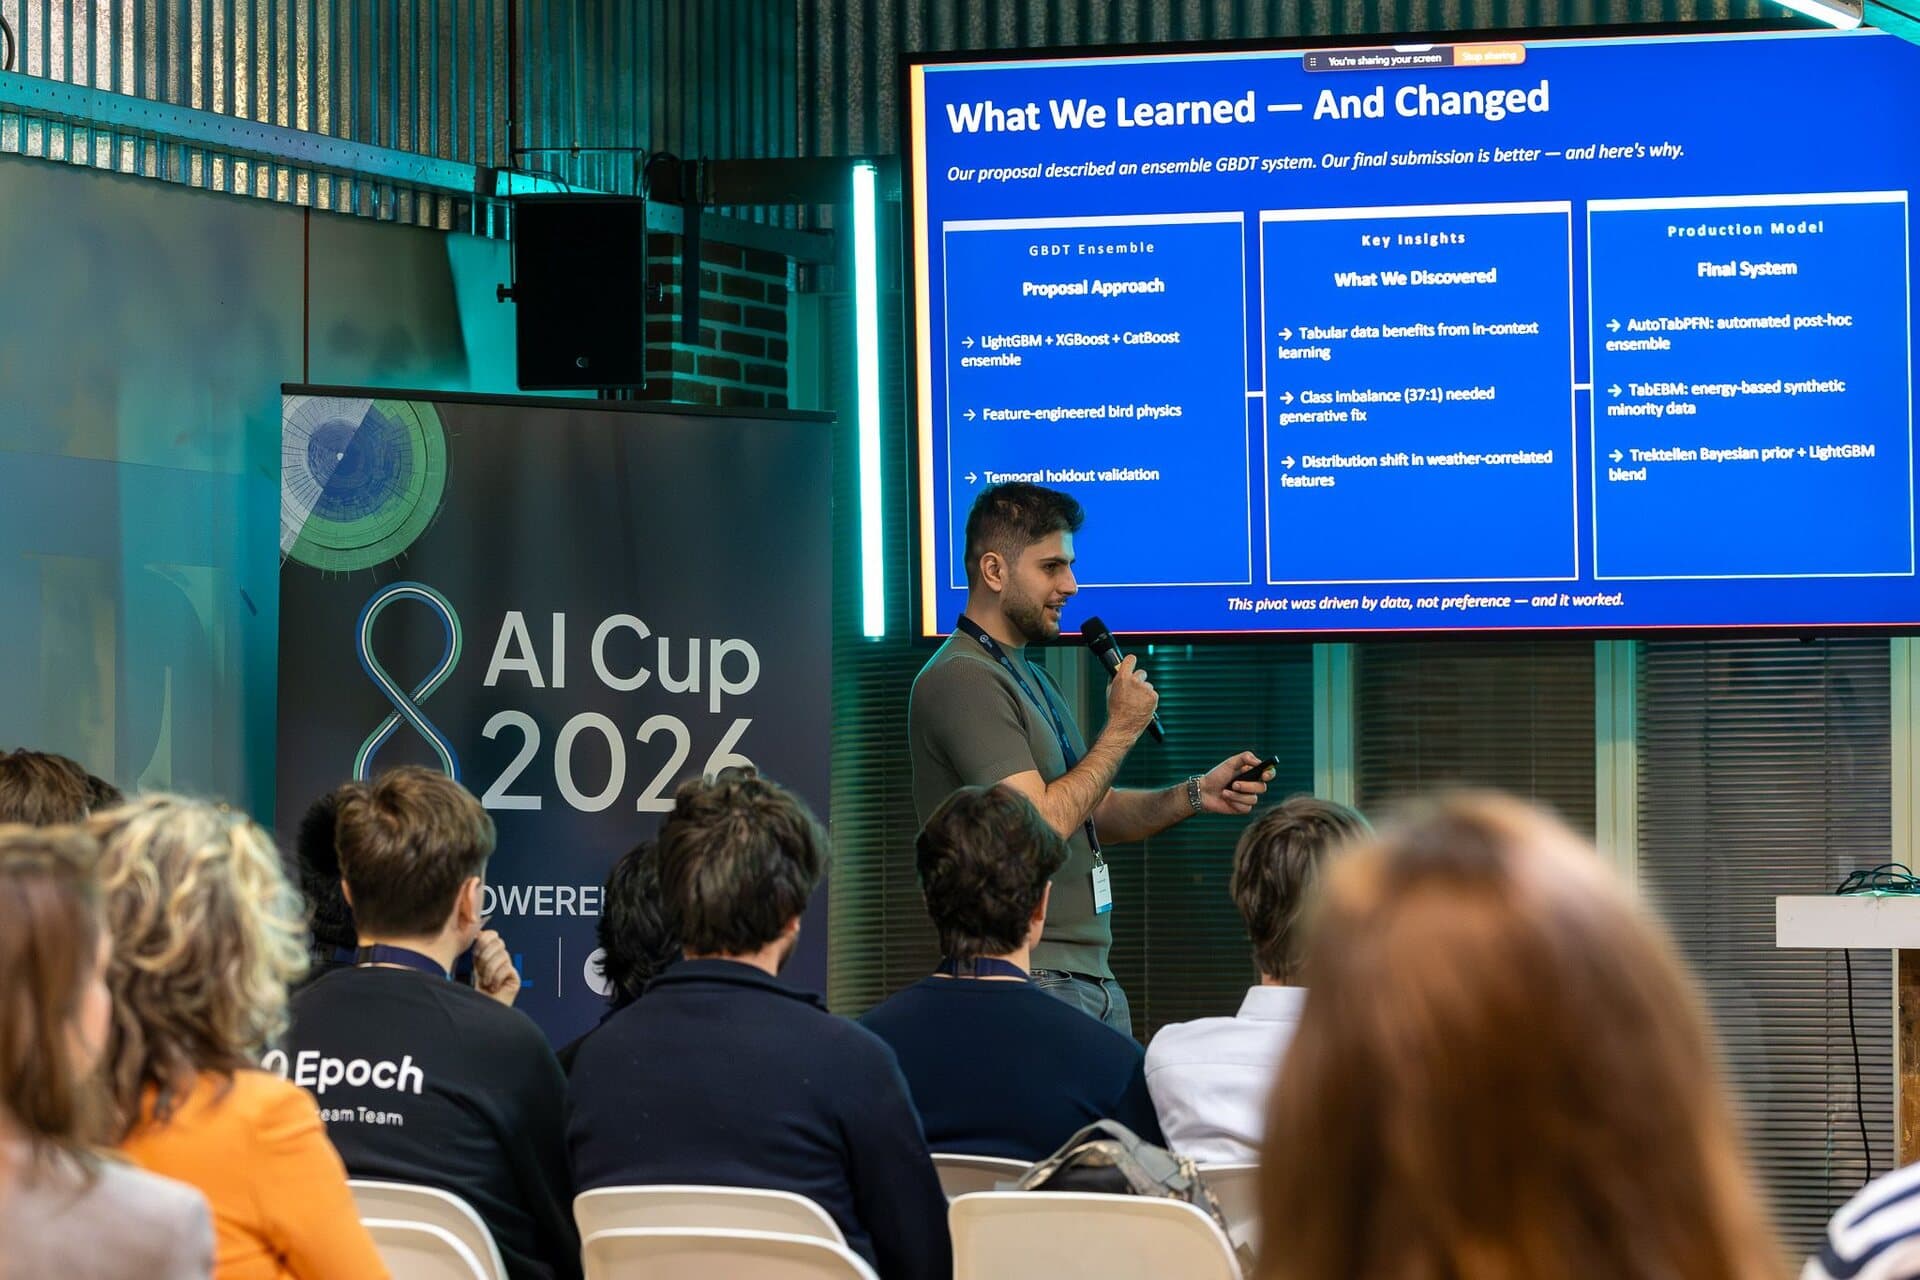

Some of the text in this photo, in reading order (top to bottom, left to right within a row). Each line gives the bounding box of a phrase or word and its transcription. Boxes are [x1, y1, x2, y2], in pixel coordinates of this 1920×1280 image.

[1329, 55, 1442, 66] You're sharing your screen
[946, 101, 1040, 133] What
[1049, 99, 1106, 129] We
[1117, 91, 1255, 127] Learned
[1314, 86, 1384, 119] And
[1395, 80, 1549, 120] Changed
[948, 167, 975, 181] Our
[978, 163, 1042, 183] proposal
[1045, 161, 1116, 177] described
[1119, 164, 1137, 175] an
[1141, 158, 1212, 174] ensemble
[1216, 156, 1259, 171] GBDT
[1261, 157, 1316, 173] system.
[1322, 154, 1350, 168] Our
[1351, 152, 1387, 170] final
[1390, 150, 1474, 165] submission
[1478, 149, 1490, 162] is
[1494, 147, 1541, 162] better
[1566, 144, 1595, 159] and
[1599, 143, 1645, 158] here's
[1650, 142, 1683, 159] why.
[1668, 221, 1823, 237] Production Model
[1029, 242, 1153, 256] GBDT Ensemble
[1362, 232, 1465, 248] Key Insights
[1334, 268, 1496, 287] What We Discovered
[1698, 261, 1797, 279] Final System
[1023, 278, 1164, 298] Proposal Approach
[1299, 322, 1538, 339] Tabular data benefits from in-context
[1627, 313, 1852, 331] AutoTabPFN: automated post-hoc
[982, 332, 1180, 350] LightGBM + XGBoost + CatBoost
[1606, 337, 1670, 351] ensemble
[961, 353, 1021, 367] ensemble
[1279, 346, 1331, 360] learning
[1300, 386, 1495, 403] Class imbalance (37:1) needed
[1629, 379, 1845, 397] TabEBM: energy-based synthetic
[983, 404, 1182, 422] Feature-engineered bird physics
[1280, 408, 1367, 426] generative fix
[1608, 401, 1696, 417] minority data
[1302, 450, 1552, 468] Distribution shift in weather-correlated
[1630, 445, 1875, 462] Trektellen Bayesian prior + LightGBM
[984, 468, 1159, 483] Temporal holdout validation
[1281, 474, 1335, 487] features
[1609, 467, 1646, 481] blend
[1228, 598, 1253, 610] This
[1255, 598, 1288, 612] pivot
[1291, 600, 1316, 609] was
[1319, 597, 1358, 609] driven
[1362, 596, 1378, 611] by
[1380, 596, 1413, 610] data,
[1417, 597, 1439, 608] not
[1441, 594, 1511, 610] preference
[1531, 593, 1557, 607] and
[1560, 594, 1570, 606] it
[1572, 593, 1624, 606] worked.
[483, 611, 760, 713] AI Cup
[481, 885, 606, 916] OWERE
[295, 1050, 424, 1094] Epoch
[319, 1106, 403, 1126] eam Team
